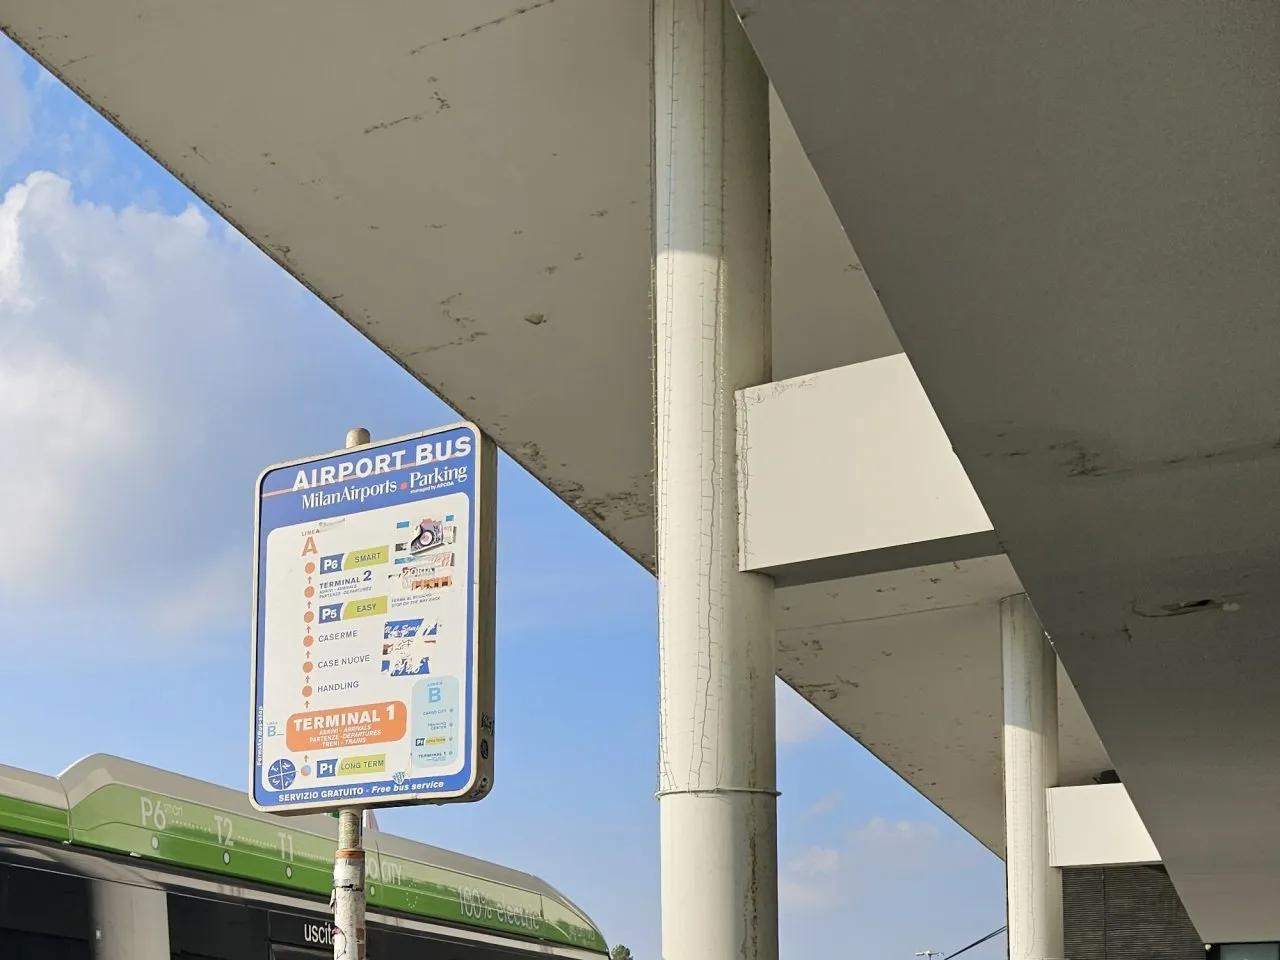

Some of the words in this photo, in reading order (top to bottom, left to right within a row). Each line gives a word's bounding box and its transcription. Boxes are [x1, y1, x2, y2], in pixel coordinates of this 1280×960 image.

[292, 450, 406, 491] AIRPORT
[415, 436, 472, 467] BUS
[302, 479, 397, 510] MilanAirports
[410, 465, 468, 489] Parking
[301, 528, 320, 536] LINEA
[301, 536, 318, 556] A
[324, 559, 338, 571] P6
[354, 552, 381, 563] SMART
[319, 577, 360, 589] TERMINAL
[363, 570, 371, 581] 2
[322, 608, 337, 620] P5
[357, 603, 377, 612] EASY
[318, 630, 358, 643] CASERME
[318, 659, 339, 669] CASE
[341, 654, 370, 665] NUOVE
[317, 681, 359, 693] HANDLING
[429, 687, 441, 703] B
[294, 710, 380, 732] TERMINAL
[386, 704, 395, 721] 1
[268, 726, 276, 737] B
[322, 740, 340, 748] TRENI
[320, 763, 333, 775] P1
[341, 762, 360, 771] LONG
[364, 760, 384, 768] TERM
[278, 792, 319, 802] SERVIZIO
[321, 786, 364, 798] GRATUITO
[371, 785, 391, 794] Free
[394, 783, 409, 791] bus
[411, 781, 444, 790] service
[140, 796, 166, 831] P6
[214, 814, 234, 847] T2
[278, 832, 293, 862] T1
[458, 885, 492, 920] 100%
[497, 894, 540, 930] electric
